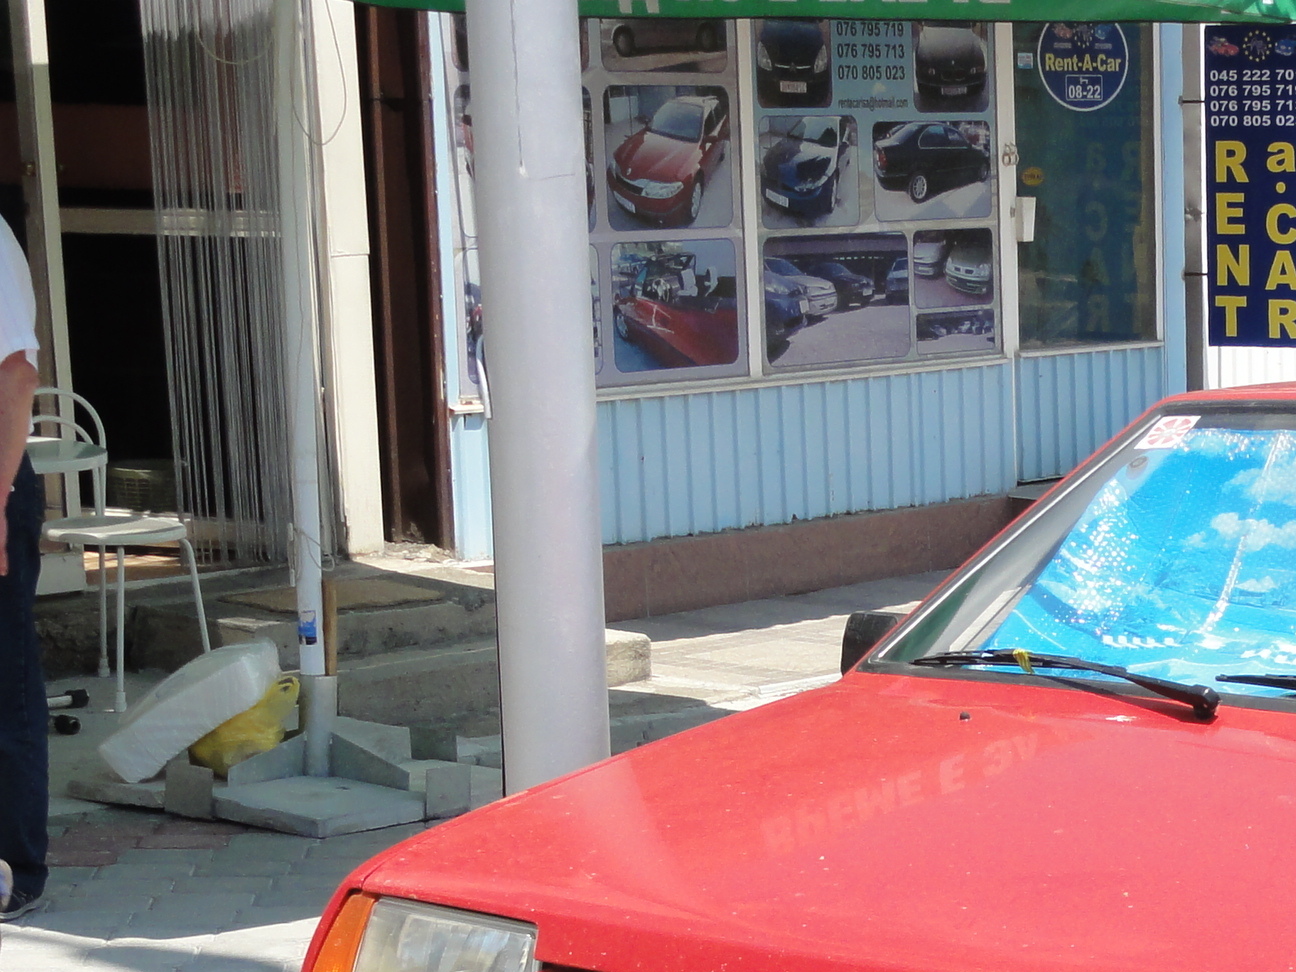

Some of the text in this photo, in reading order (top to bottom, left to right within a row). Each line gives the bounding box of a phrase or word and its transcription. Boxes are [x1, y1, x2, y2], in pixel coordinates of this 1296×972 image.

[836, 21, 904, 37] 076 795 719
[837, 43, 905, 59] 076 795 713
[1045, 53, 1122, 72] Rent-A-Car
[837, 65, 906, 80] 070 805 023
[1209, 69, 1238, 81] 045
[1242, 69, 1271, 81] 222
[1068, 85, 1101, 99] 08-22
[1209, 85, 1238, 97] 076
[1242, 85, 1271, 96] 795
[1210, 100, 1238, 112] 076
[1242, 100, 1271, 112] 795
[1210, 115, 1238, 127] 070
[1242, 115, 1271, 127] 805
[1215, 140, 1250, 337] RENT
